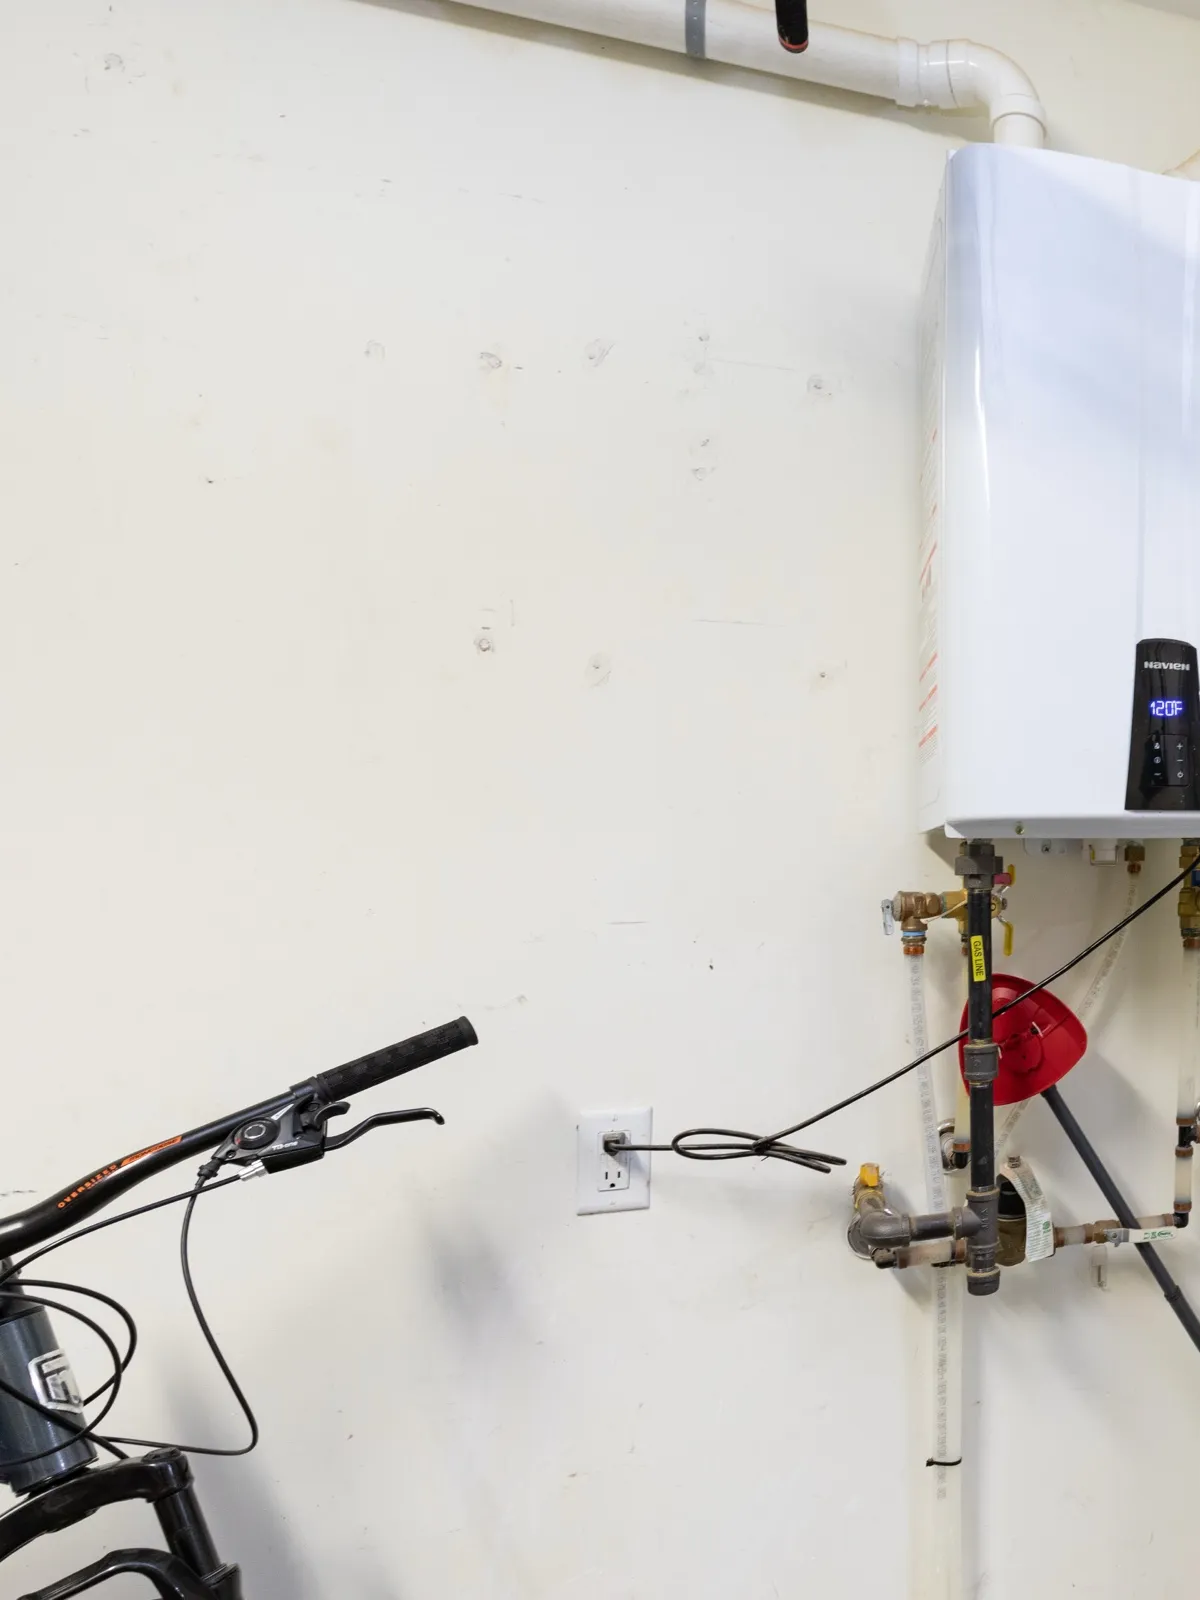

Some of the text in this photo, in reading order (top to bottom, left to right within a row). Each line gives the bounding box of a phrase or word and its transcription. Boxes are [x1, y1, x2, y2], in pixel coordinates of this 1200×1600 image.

[973, 940, 985, 977] GAS LINE
[57, 1163, 118, 1209] OVERSIZED
